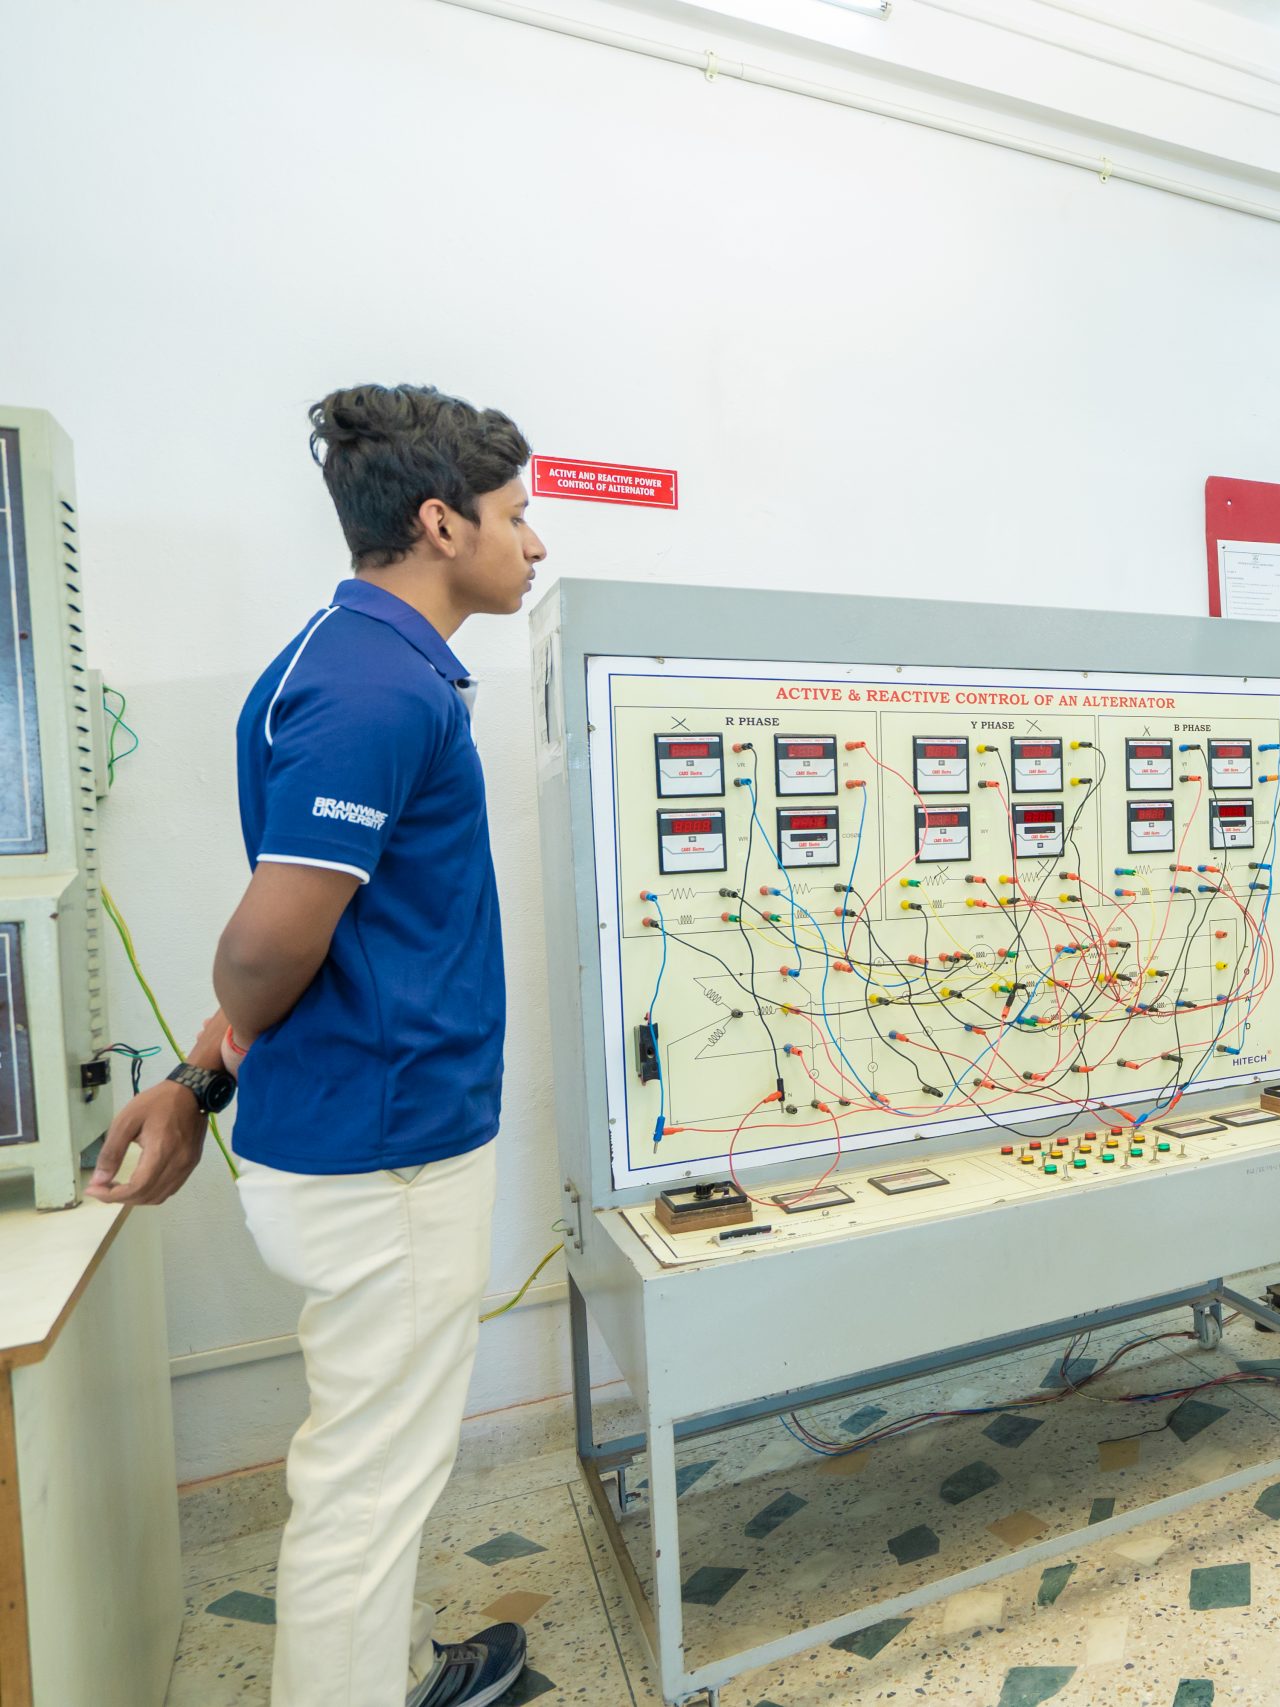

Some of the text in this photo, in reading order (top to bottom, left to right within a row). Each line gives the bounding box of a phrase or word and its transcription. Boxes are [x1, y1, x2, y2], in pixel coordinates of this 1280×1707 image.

[549, 468, 662, 488] ACTIVE AND REACTIVE POWER
[557, 479, 655, 497] CONTROL OF ALTERNATOR
[776, 687, 1176, 709] ACTIVE & REACTIVE CONTROL OF AN ALTERNATOR
[725, 717, 780, 727] R PHASE
[970, 721, 1015, 729] Y PHASE
[1174, 724, 1212, 732] B PHASE
[314, 796, 388, 820] BRAINWARE
[312, 805, 386, 831] UNIVERSITY
[1232, 1054, 1267, 1066] HITECH
